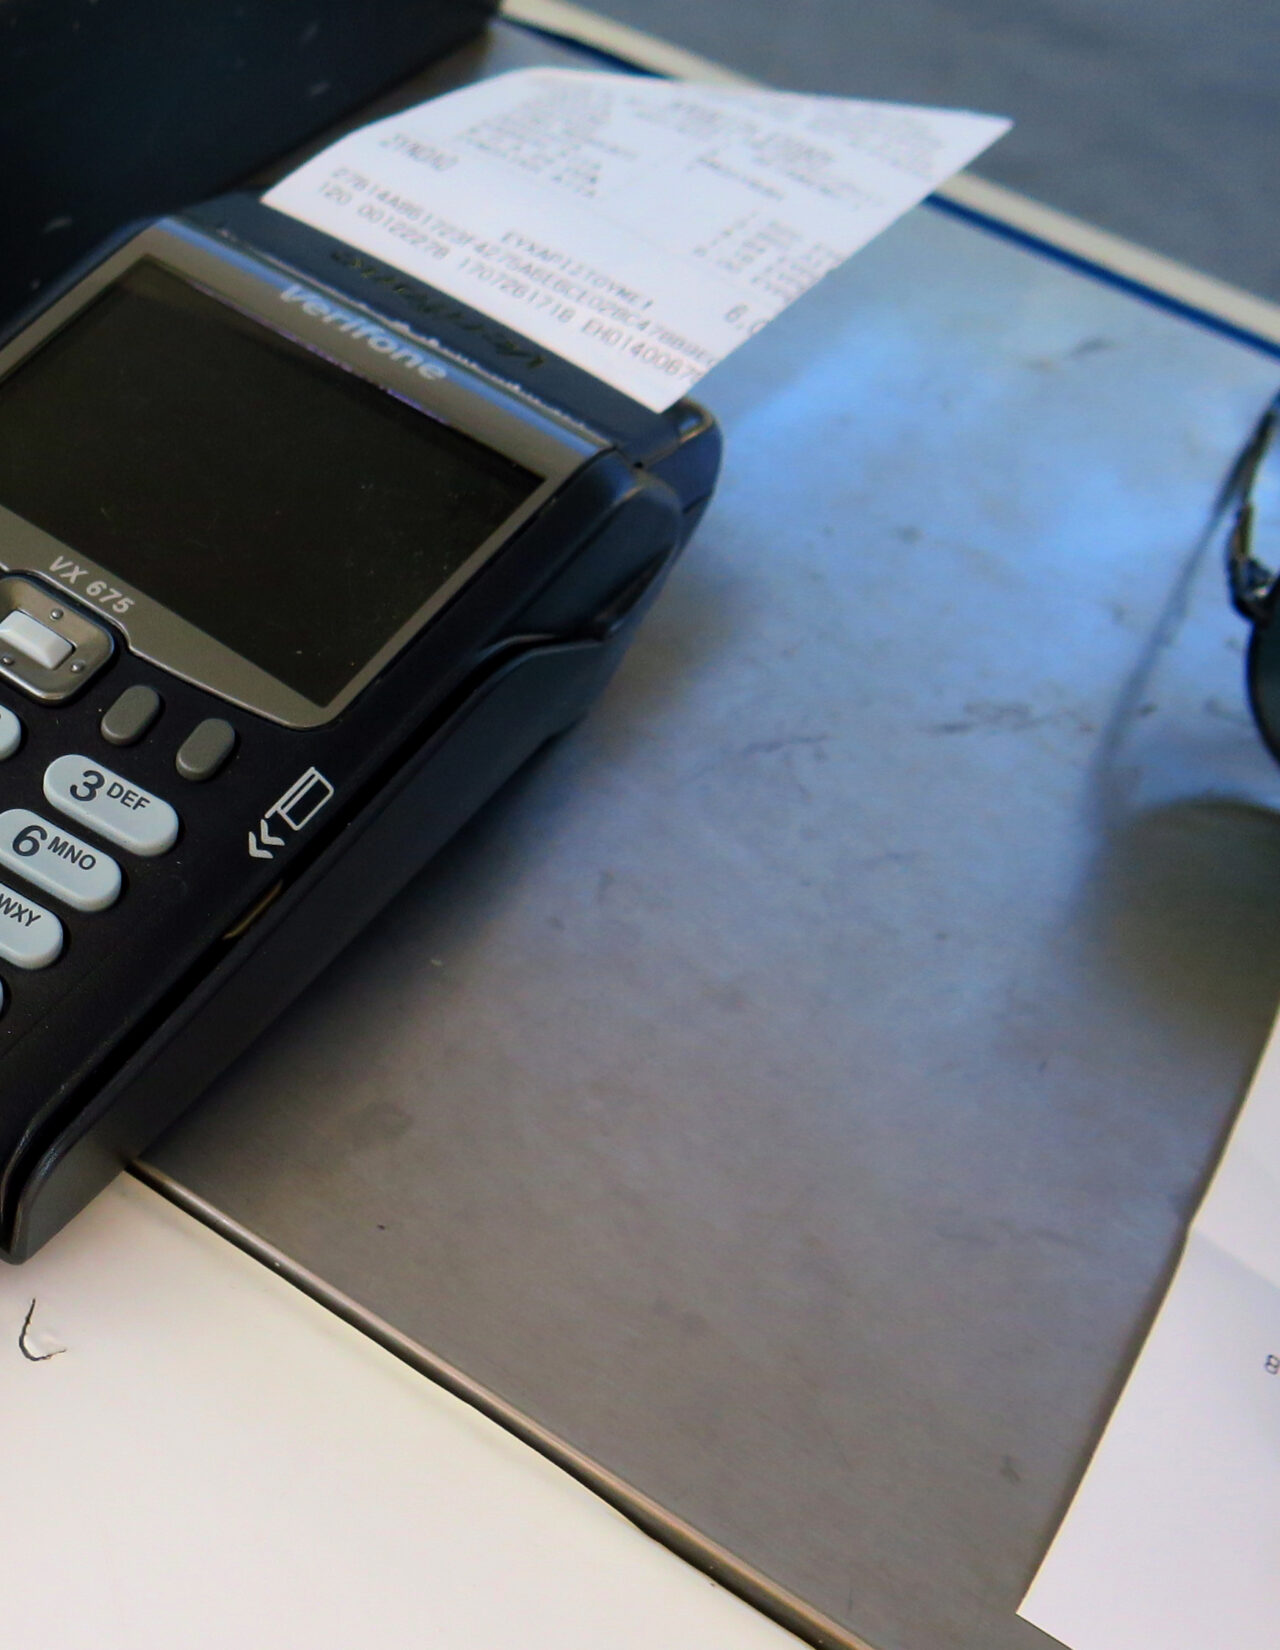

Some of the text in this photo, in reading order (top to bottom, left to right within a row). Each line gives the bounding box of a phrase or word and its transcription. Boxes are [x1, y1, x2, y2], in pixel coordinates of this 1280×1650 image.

[49, 556, 136, 614] VX 675
[69, 769, 151, 811] 3 DEF
[12, 825, 96, 870] 6 MNO
